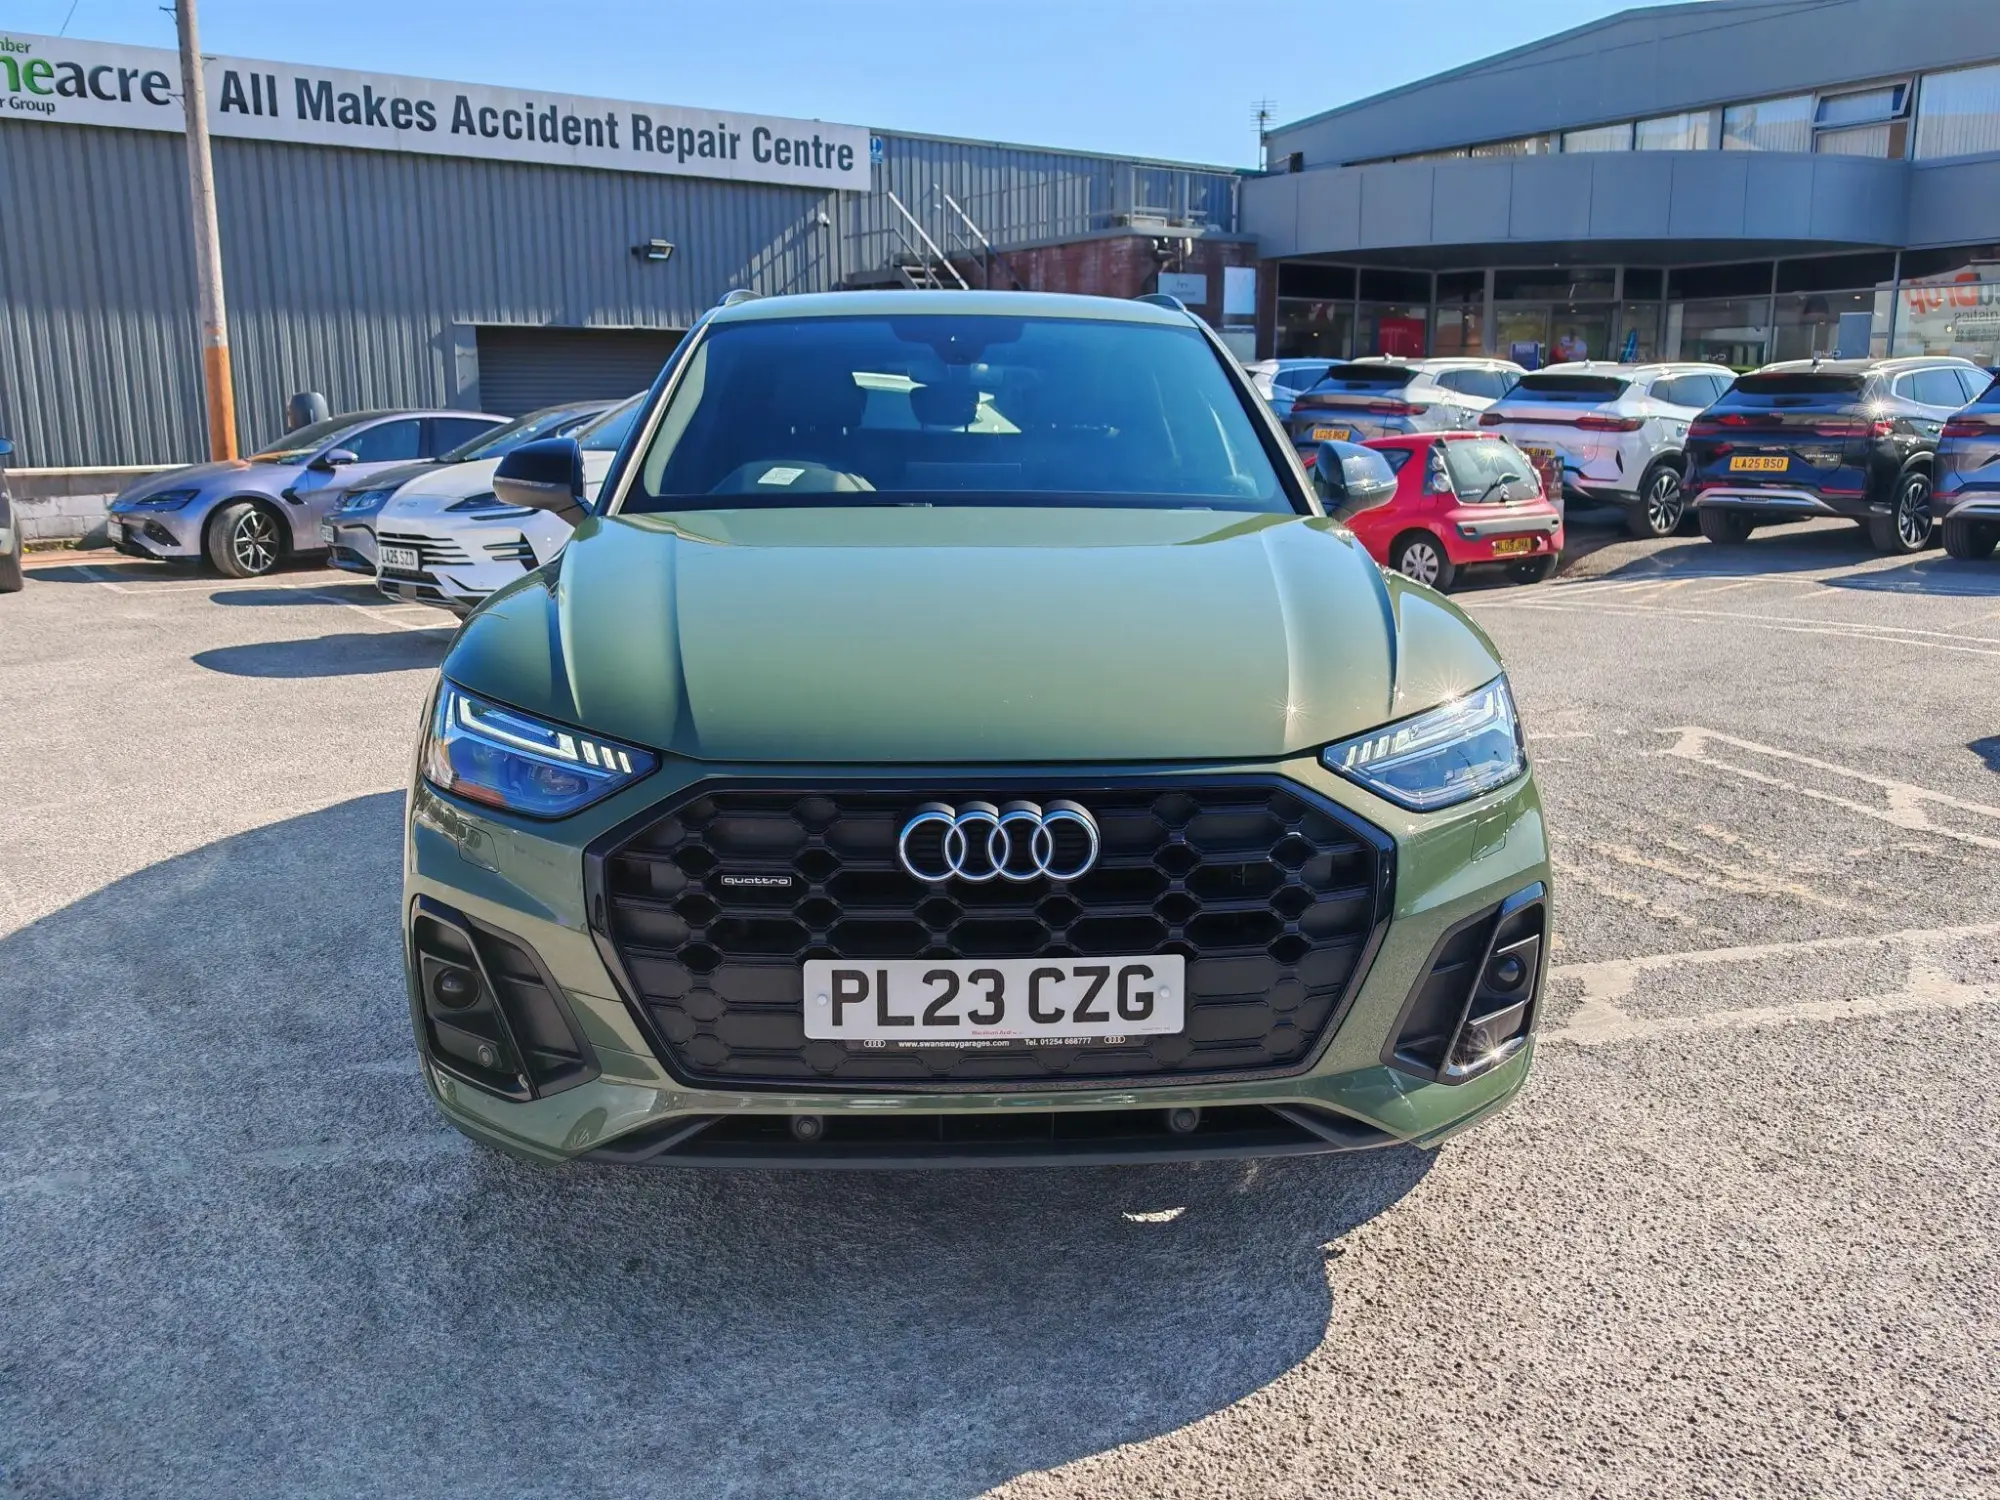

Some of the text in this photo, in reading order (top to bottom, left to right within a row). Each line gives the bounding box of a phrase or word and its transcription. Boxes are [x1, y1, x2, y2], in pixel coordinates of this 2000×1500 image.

[9, 96, 56, 116] Group
[220, 70, 854, 171] All Makes Accident Repair Centre
[1734, 458, 1760, 469] LA25
[723, 877, 789, 885] quattro
[832, 964, 1155, 1027] PL23 CZG
[898, 1040, 1010, 1048] www.swanswaygarages.com
[1024, 1038, 1038, 1046] Tel.
[1040, 1038, 1063, 1046] 01254
